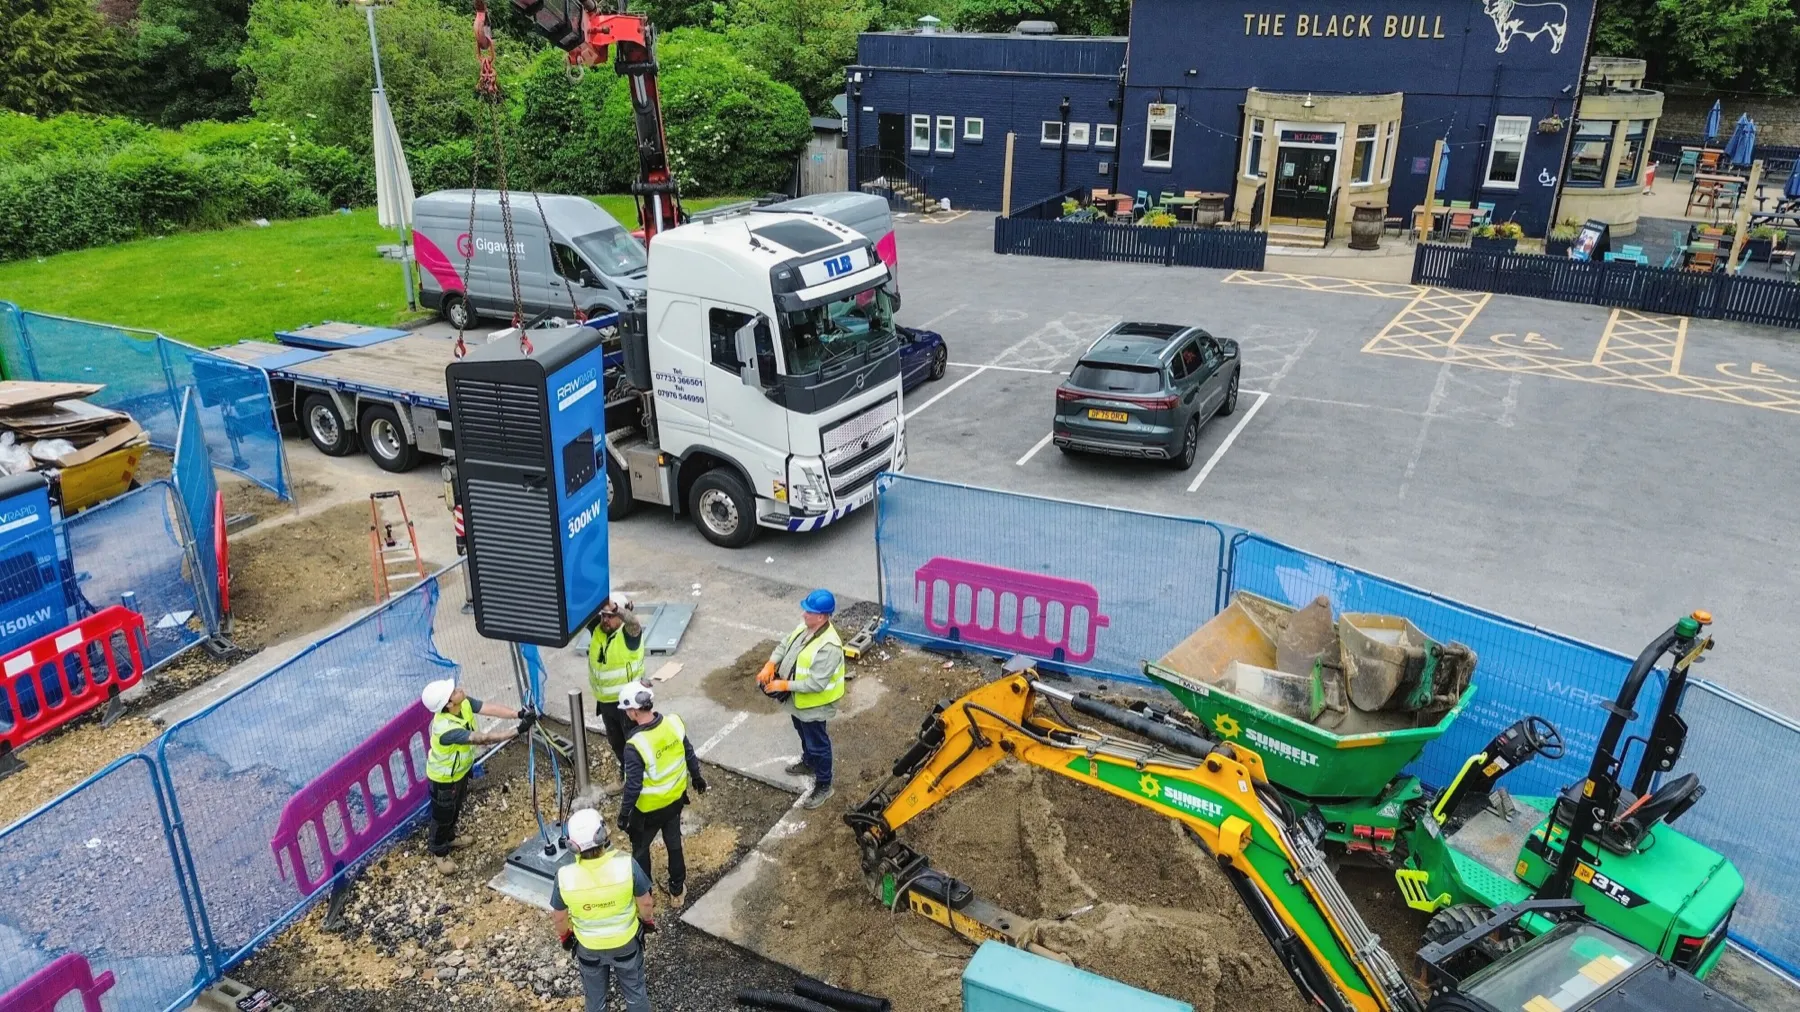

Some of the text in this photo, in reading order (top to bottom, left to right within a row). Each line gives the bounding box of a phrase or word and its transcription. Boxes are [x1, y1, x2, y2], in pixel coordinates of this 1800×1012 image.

[1243, 13, 1446, 39] THE BLACK BULL
[823, 254, 853, 278] TLB
[655, 373, 677, 383] 07733
[672, 367, 683, 375] Tel:
[568, 498, 601, 539] 300kW
[0, 606, 51, 637] 150kW
[1183, 681, 1201, 692] MAX
[1245, 727, 1319, 766] SUNBELT
[1254, 741, 1307, 767] RENTALS
[1164, 785, 1223, 816] SUNBELT
[1171, 798, 1214, 818] RENTALS
